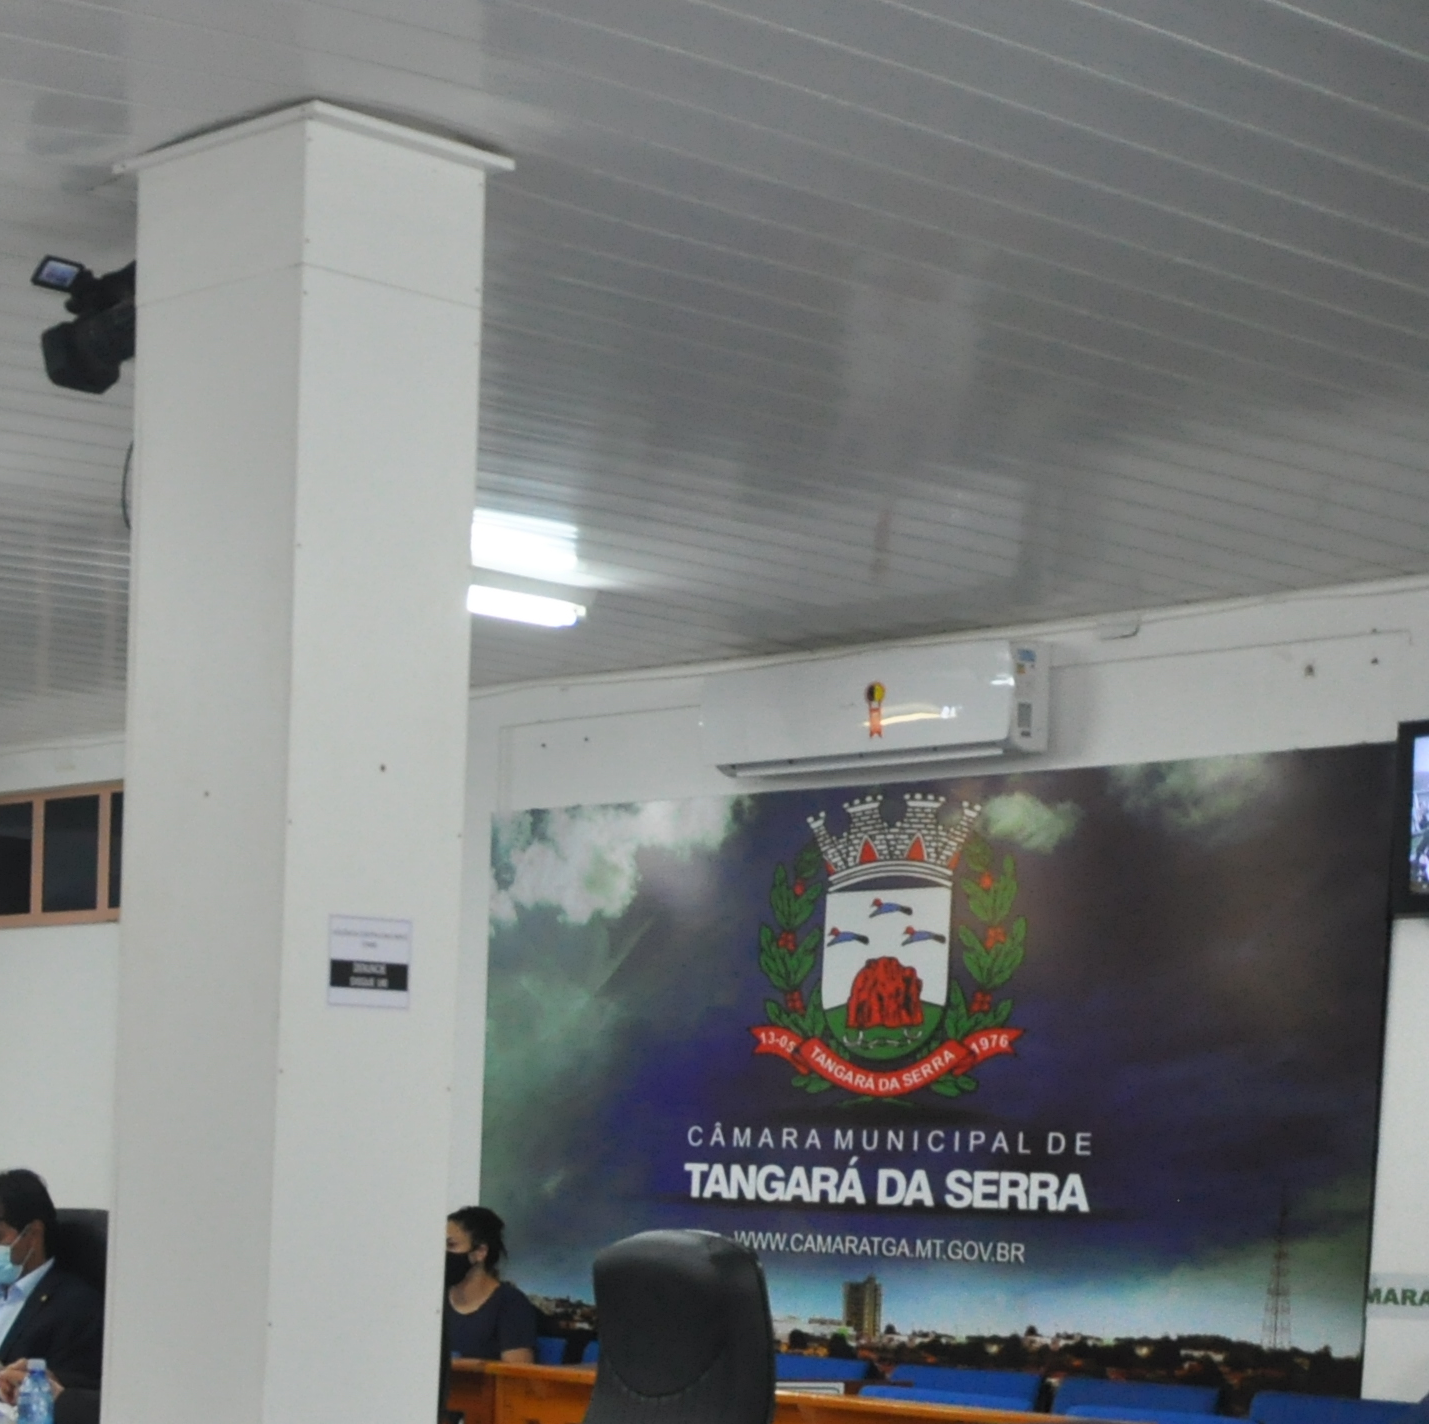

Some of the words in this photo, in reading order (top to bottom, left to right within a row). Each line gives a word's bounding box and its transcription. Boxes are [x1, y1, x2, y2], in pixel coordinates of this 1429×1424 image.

[758, 1030, 796, 1054] 13-05
[969, 1034, 1010, 1055] 1976
[809, 1045, 876, 1091] TANGARÁ
[878, 1078, 901, 1092] DA
[902, 1049, 956, 1086] SERRA
[686, 1122, 823, 1150] CÂMARA
[833, 1129, 1032, 1155] MUNICIPAL
[1047, 1132, 1093, 1156] DE
[683, 1155, 866, 1205] TANGARÁ
[876, 1168, 935, 1207] DA
[944, 1170, 1091, 1213] SERRA
[733, 1230, 1027, 1264] WWW.CAMARATGA.MT.GOV.BR
[1367, 1287, 1429, 1307] MARA
